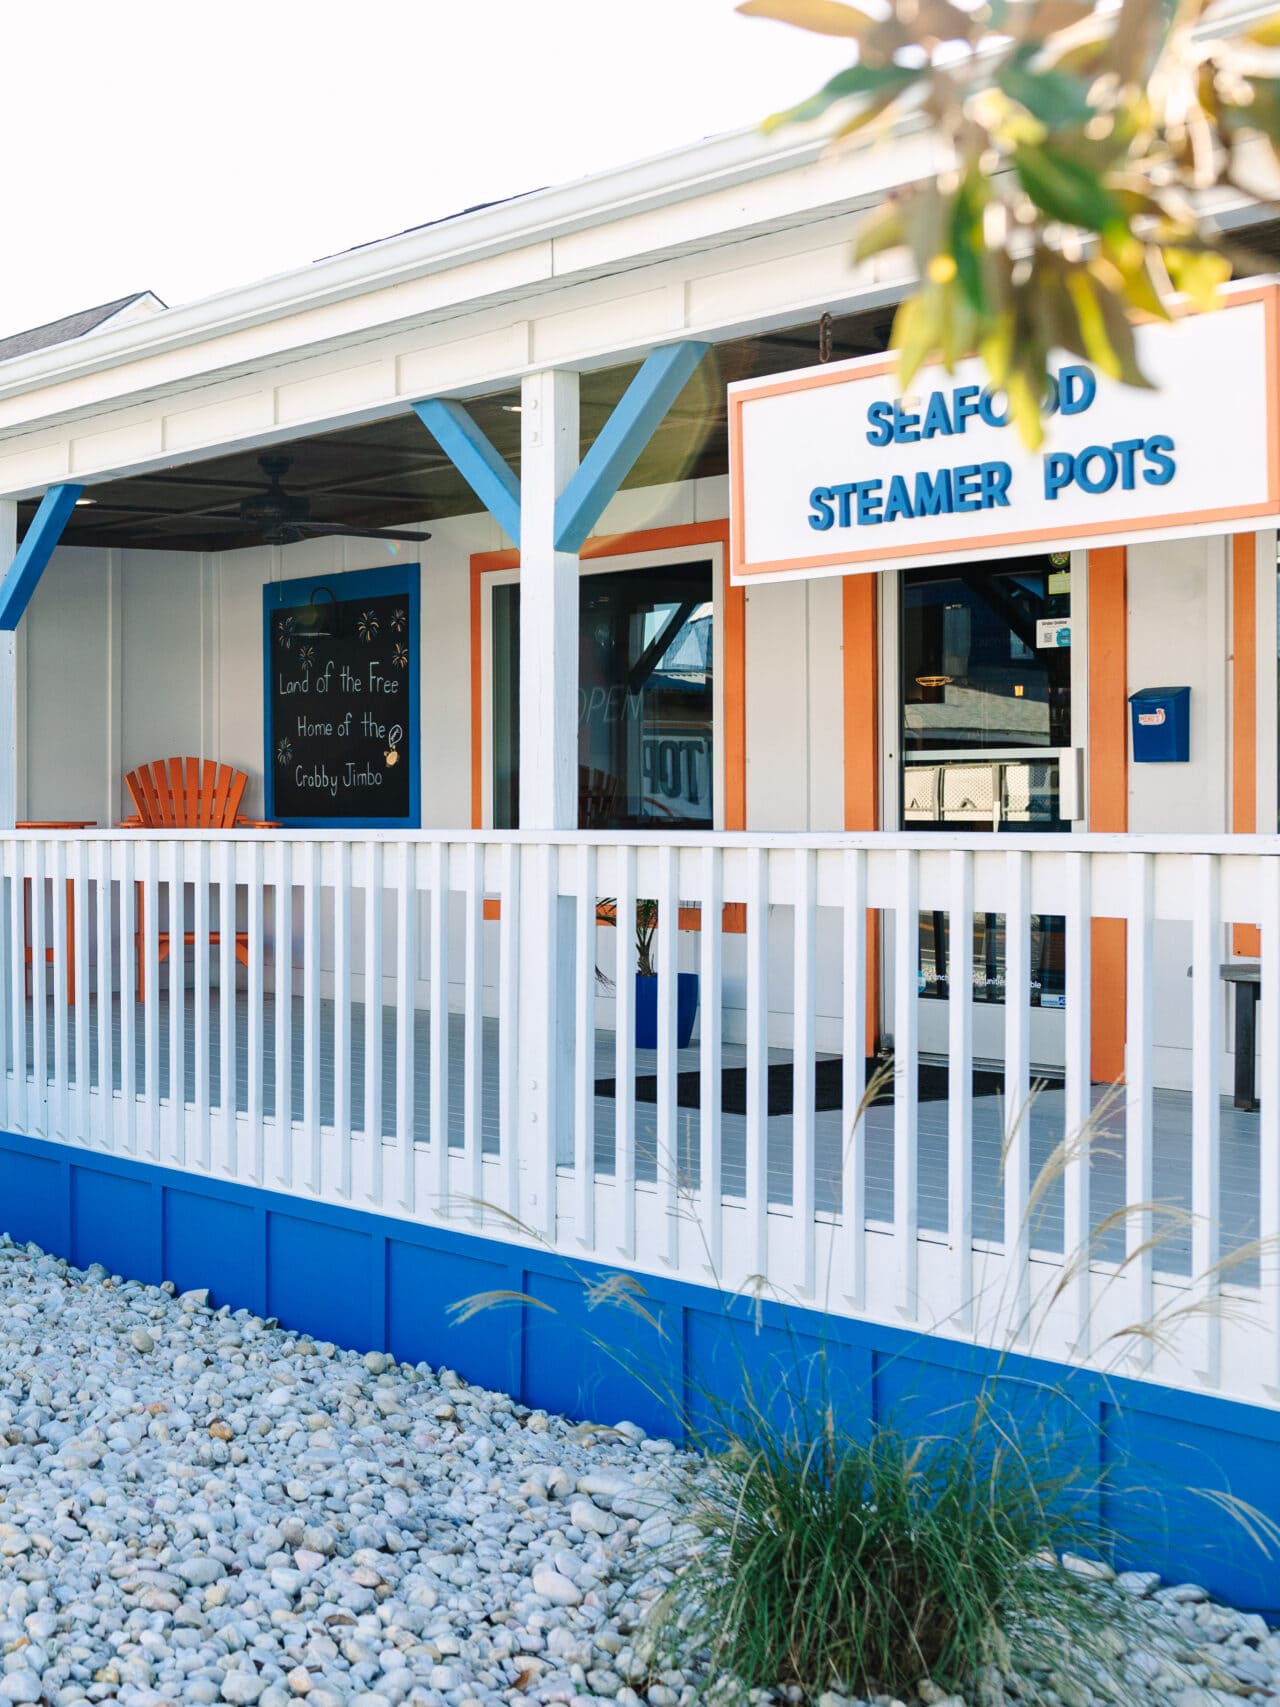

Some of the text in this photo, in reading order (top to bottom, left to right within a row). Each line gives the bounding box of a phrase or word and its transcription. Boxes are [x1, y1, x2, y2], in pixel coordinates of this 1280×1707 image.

[808, 434, 1176, 531] STEAMER POTS
[280, 660, 400, 695] Land of the Free
[297, 716, 333, 737] Home
[338, 712, 353, 737] of
[361, 711, 386, 738] the
[295, 762, 382, 796] Crabby Jimbo
